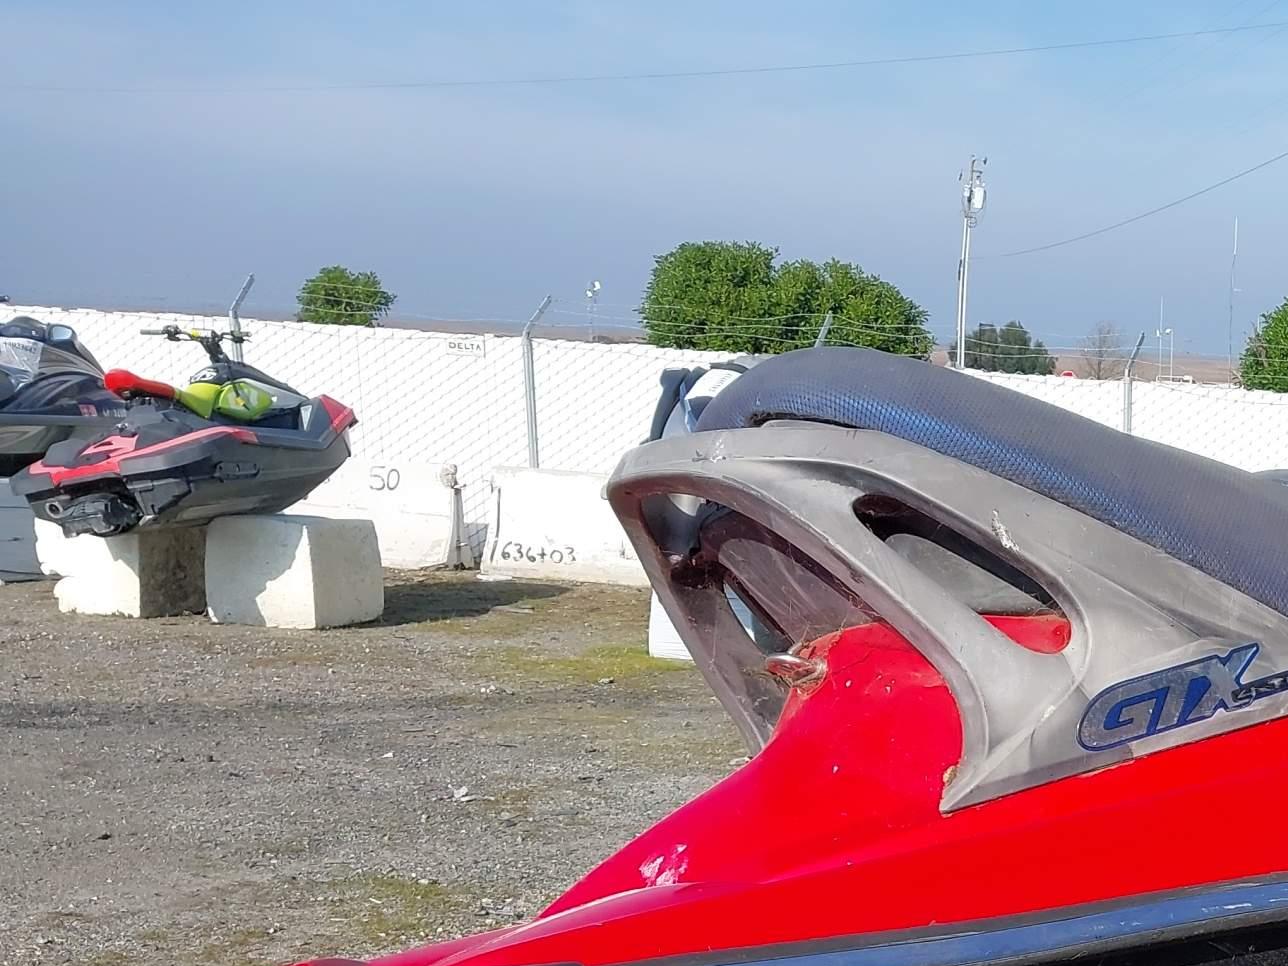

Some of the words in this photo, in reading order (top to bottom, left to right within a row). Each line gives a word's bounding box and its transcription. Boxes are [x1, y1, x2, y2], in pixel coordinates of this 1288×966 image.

[448, 341, 482, 351] DELTA
[369, 465, 400, 491] 50
[1078, 643, 1260, 751] GTX
